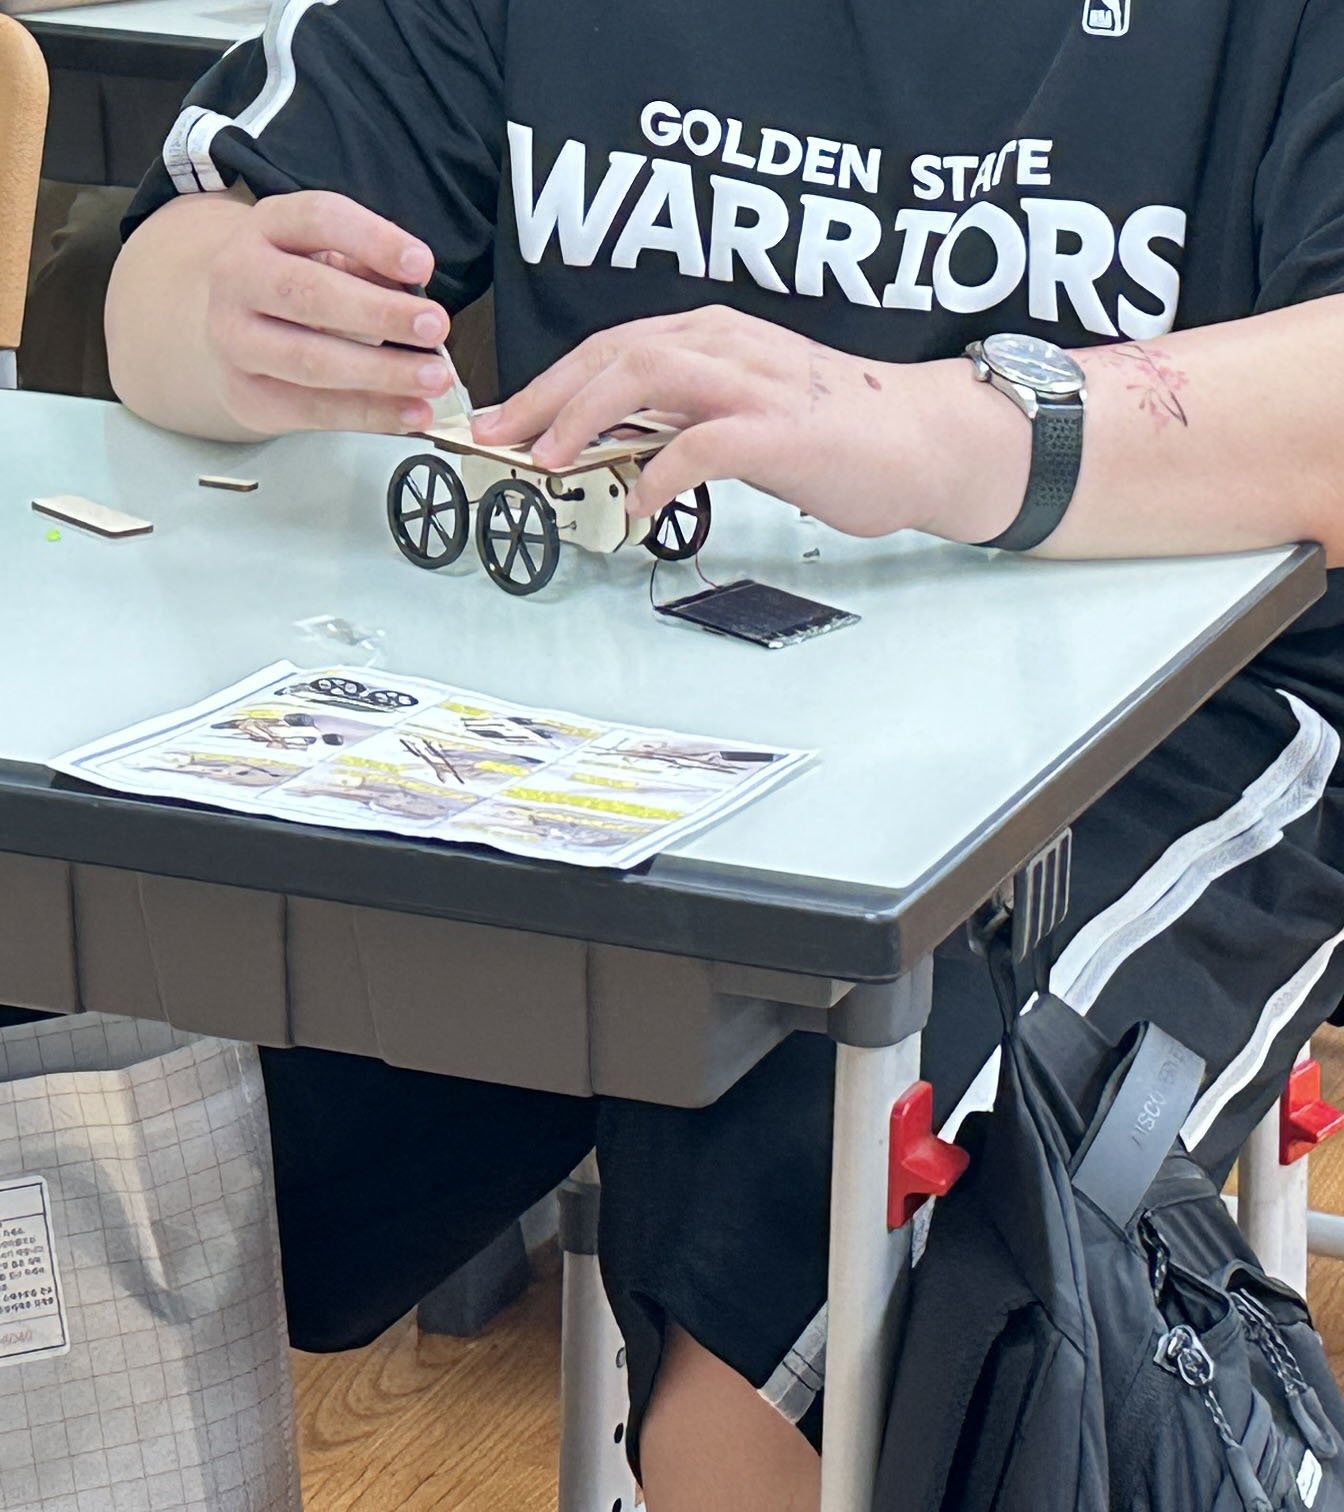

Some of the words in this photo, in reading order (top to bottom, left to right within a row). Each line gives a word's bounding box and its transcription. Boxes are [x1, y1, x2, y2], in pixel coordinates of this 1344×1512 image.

[506, 120, 1187, 341] WARRIORS
[640, 100, 882, 194] GOLDEN
[910, 138, 1054, 203] STATE
